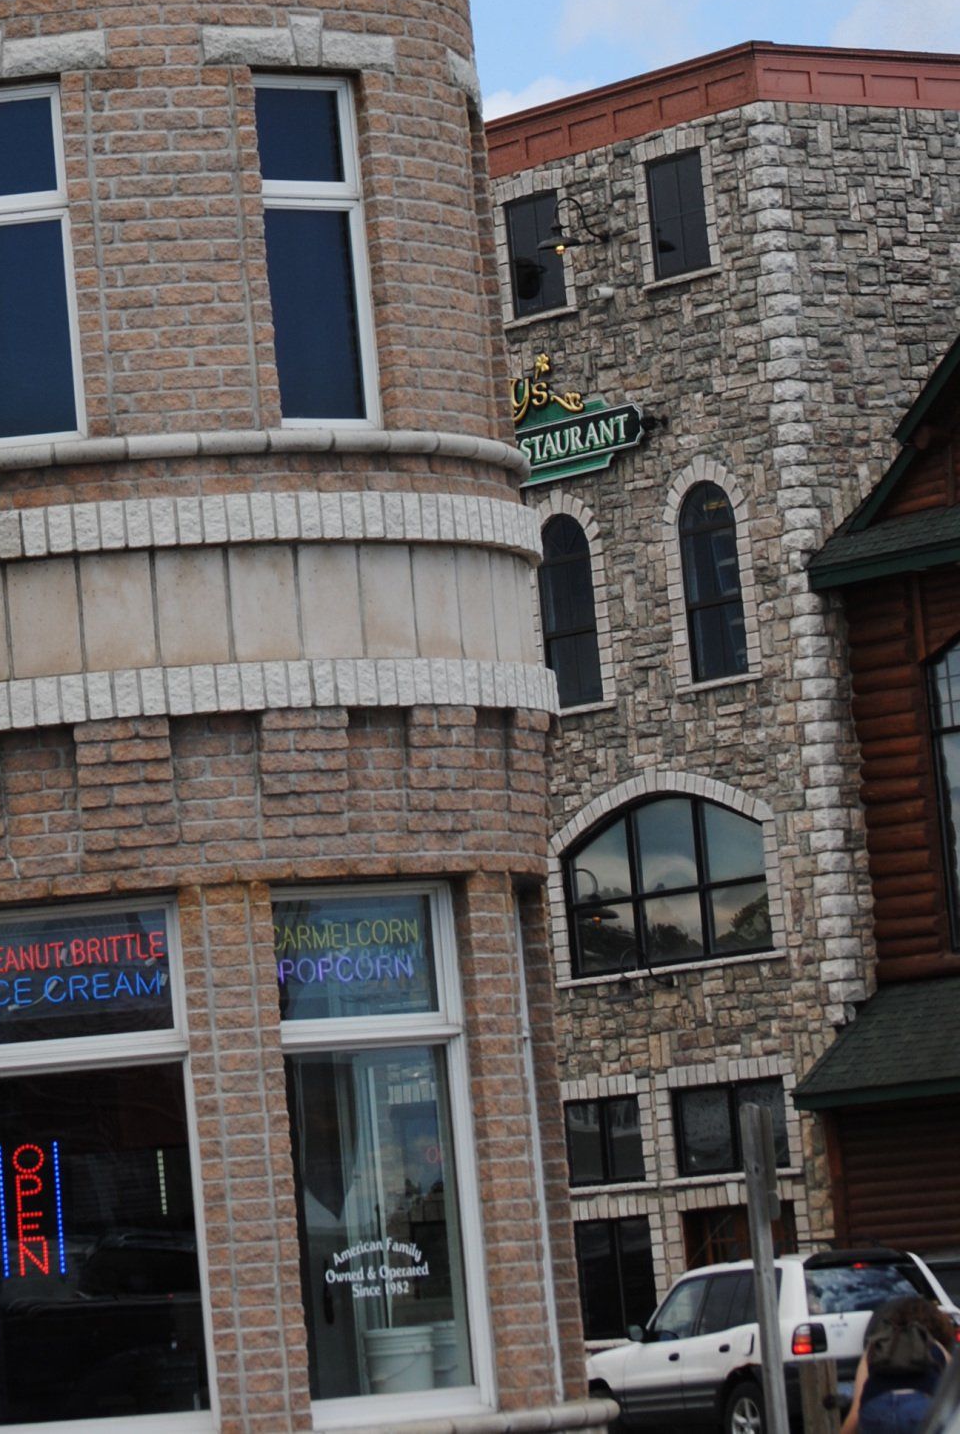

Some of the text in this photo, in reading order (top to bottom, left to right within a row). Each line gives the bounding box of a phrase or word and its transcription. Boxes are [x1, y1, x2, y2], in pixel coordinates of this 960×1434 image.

[69, 930, 165, 967] BRITTLE
[277, 953, 415, 985] POPCORN
[43, 969, 162, 1004] CREAM
[12, 1143, 50, 1277] OPEN
[332, 1236, 422, 1267] American Family
[325, 1261, 430, 1284] Owned & Operated
[351, 1280, 410, 1298] Since 1982
